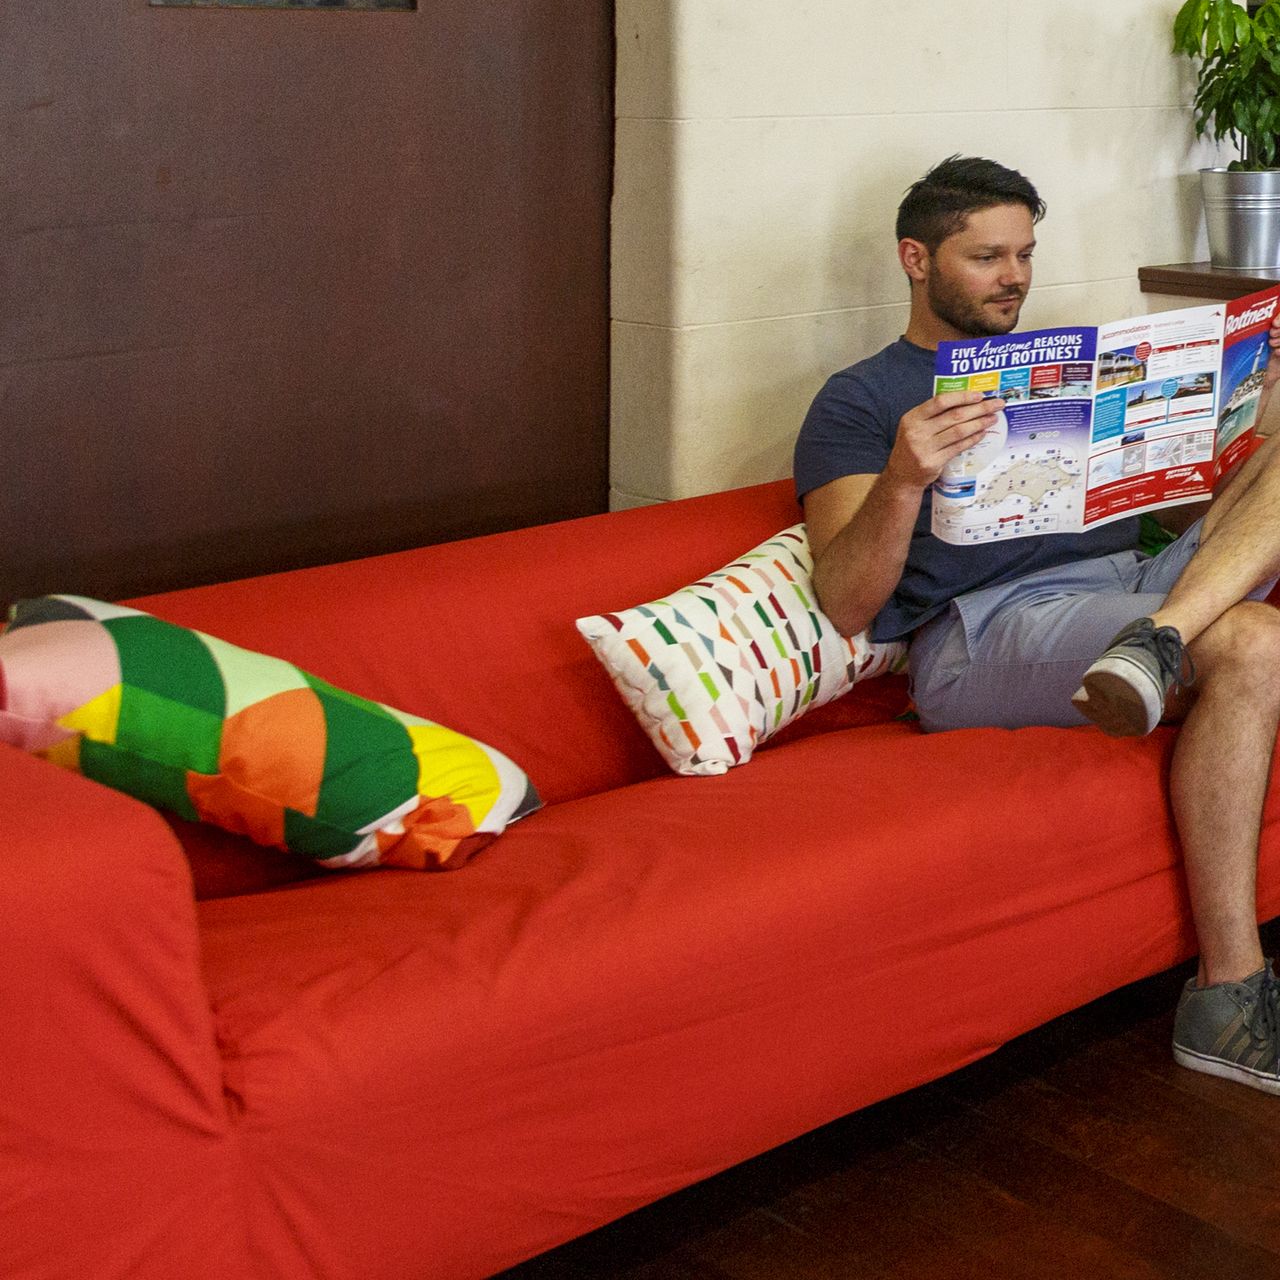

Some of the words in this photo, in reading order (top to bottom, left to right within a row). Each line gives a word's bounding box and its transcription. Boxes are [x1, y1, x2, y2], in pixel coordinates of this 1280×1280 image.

[1225, 301, 1277, 336] Rottnest
[951, 347, 977, 360] FIVE
[978, 340, 1032, 357] Awesome
[1034, 334, 1082, 349] REASONS
[951, 360, 970, 373] TO
[972, 354, 1007, 371] VISIT
[1011, 346, 1082, 366] ROTTNEST
